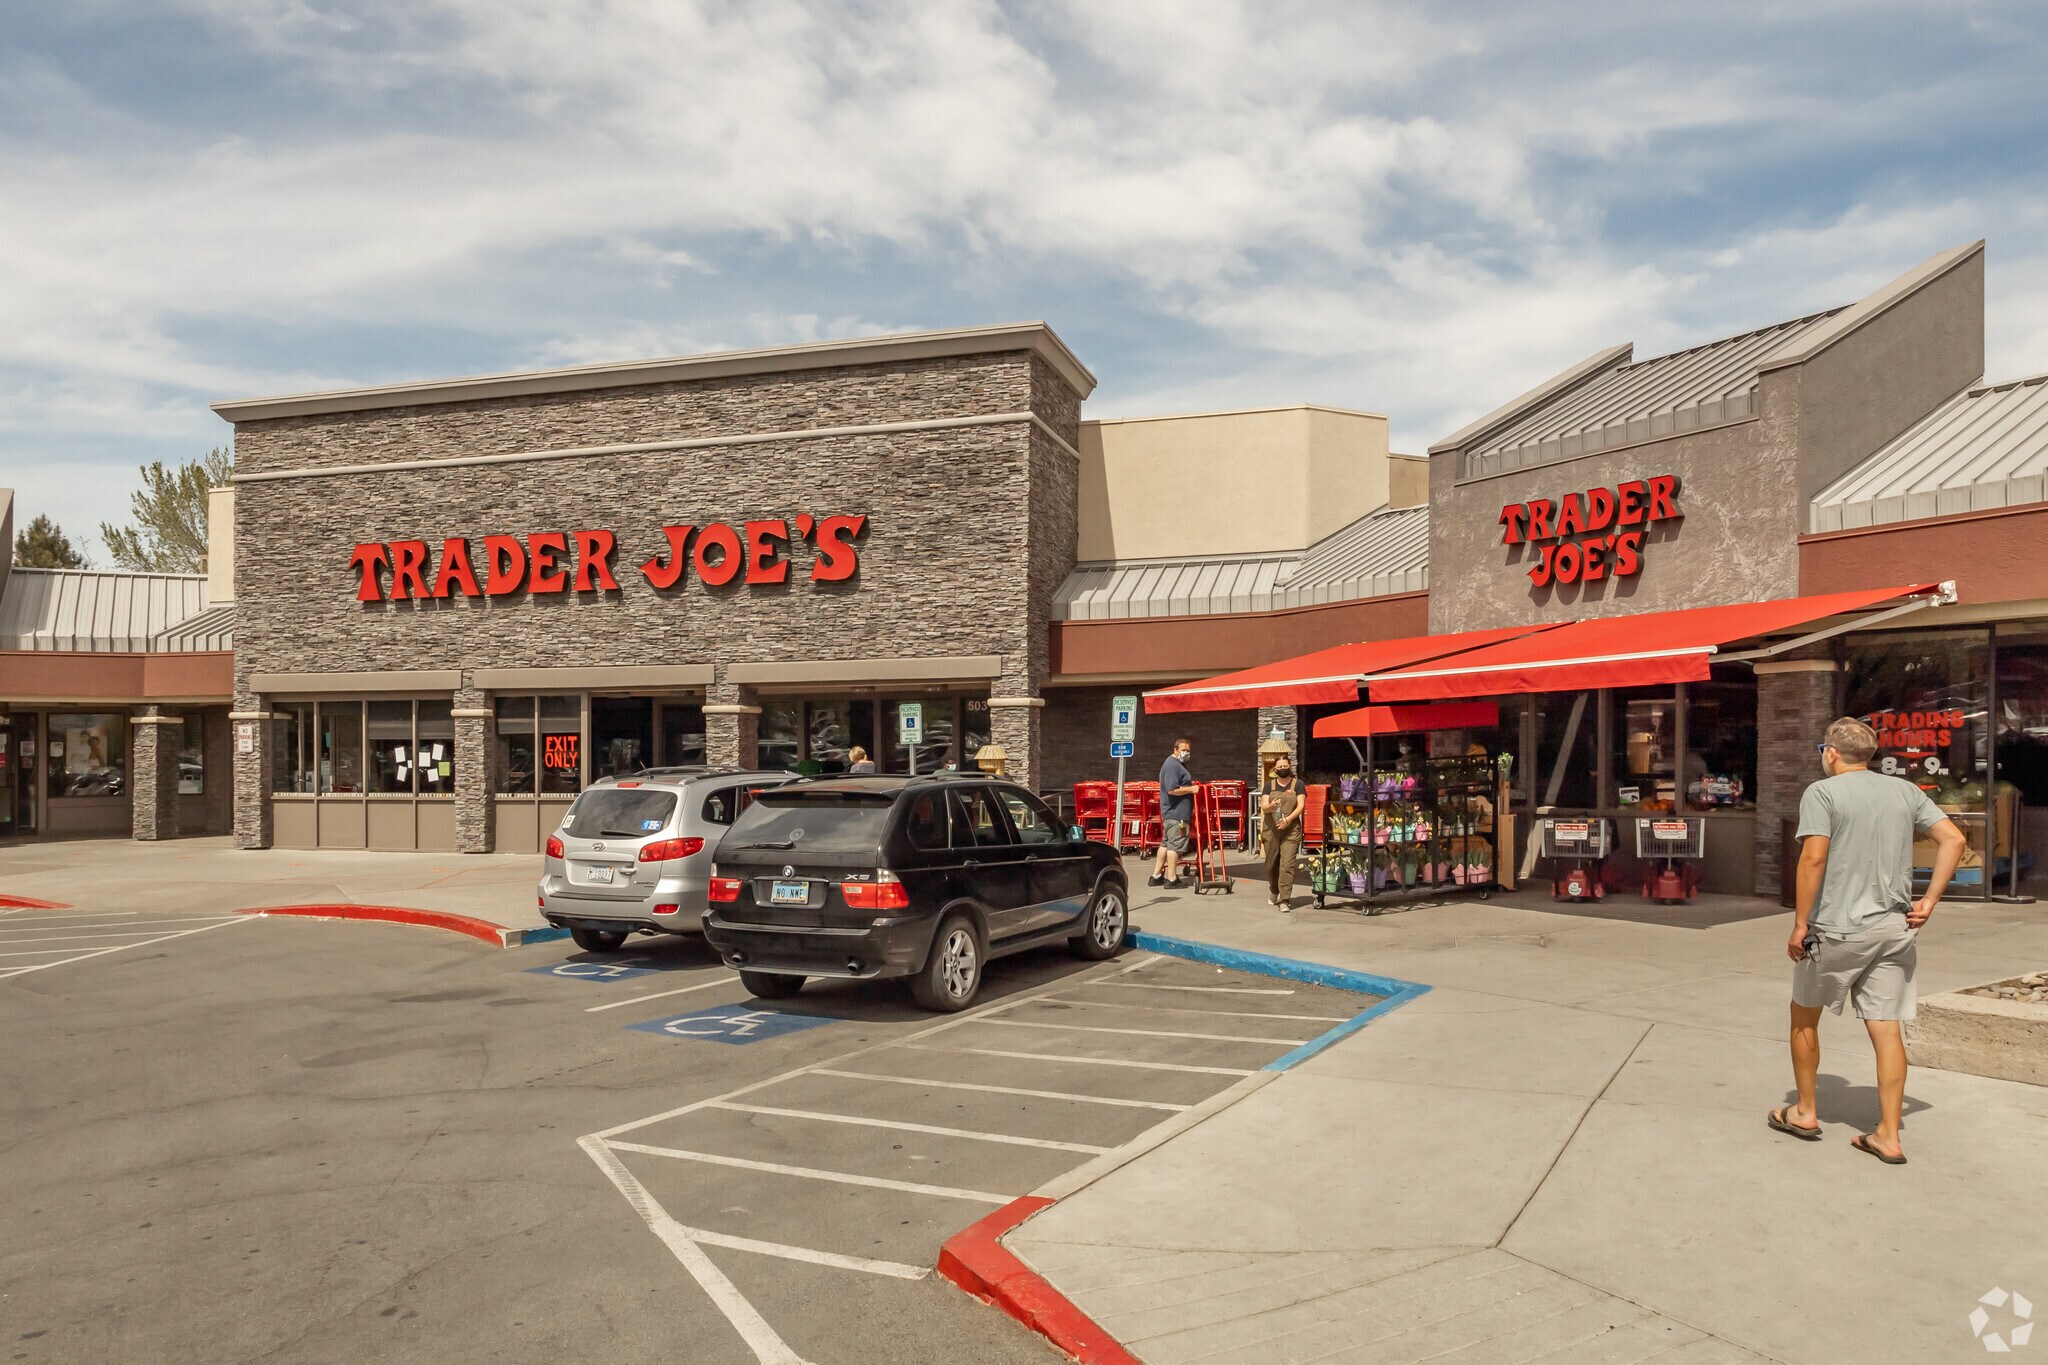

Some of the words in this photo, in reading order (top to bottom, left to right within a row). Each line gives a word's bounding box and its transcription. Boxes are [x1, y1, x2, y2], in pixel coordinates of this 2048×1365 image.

[1498, 475, 1681, 544] TRADER
[348, 529, 620, 600] TRADER
[639, 513, 867, 588] JOE'S
[1526, 531, 1645, 588] JOE'S
[968, 701, 988, 711] 503
[1868, 710, 1965, 728] TRADING
[546, 736, 577, 751] EXIT
[1878, 729, 1951, 747] HOURS
[545, 752, 578, 768] ONLY
